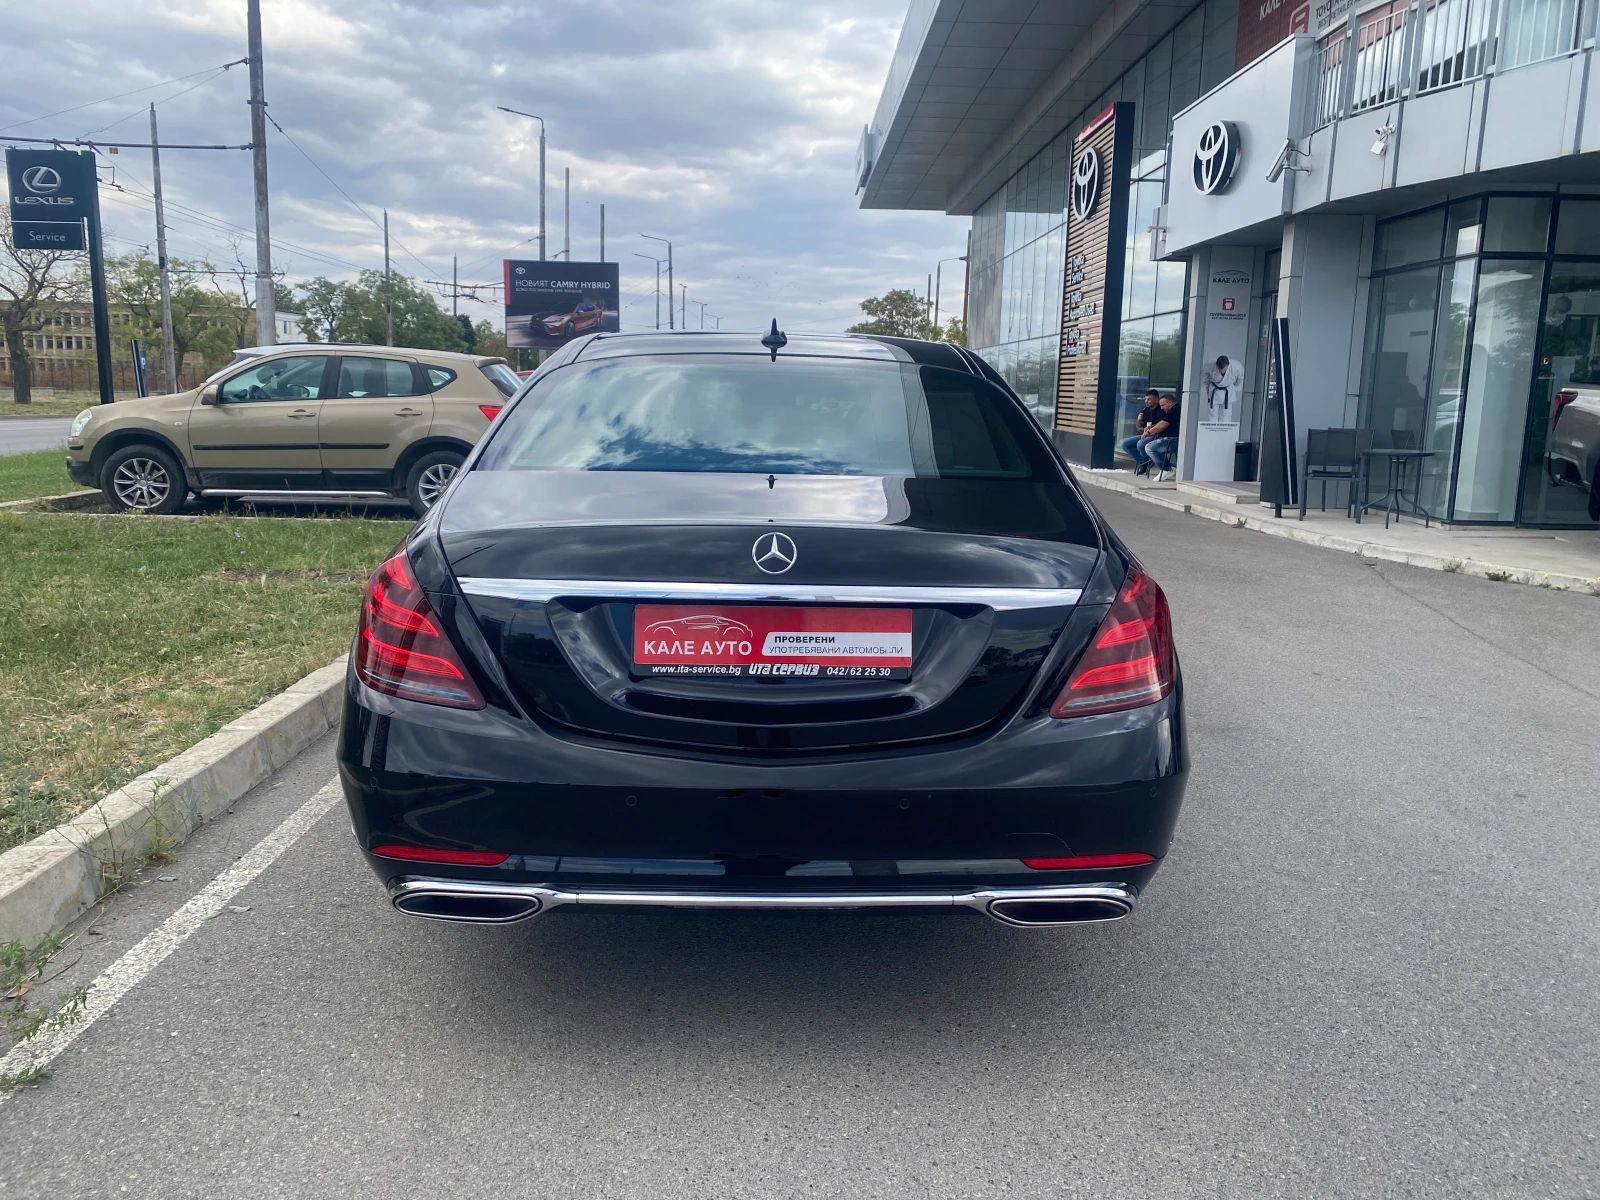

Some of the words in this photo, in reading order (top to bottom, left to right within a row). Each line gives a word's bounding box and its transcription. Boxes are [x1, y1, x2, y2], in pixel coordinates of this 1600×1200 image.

[14, 196, 75, 206] LEXUS
[28, 230, 66, 242] Service
[515, 279, 549, 288] НОВИЯТ
[550, 281, 579, 289] CAMRY
[580, 281, 611, 289] HYBRID
[774, 636, 836, 644] ПРОВЕРЕНИ
[644, 640, 695, 655] КАЛЕ
[700, 640, 752, 656] АУТО
[769, 646, 841, 654] УПОТРЕБЯВАНИ
[842, 646, 904, 655] АВТОМОБЛИ
[651, 664, 742, 676] www.ita-service.bg
[864, 667, 877, 676] 25
[879, 667, 891, 677] 30
